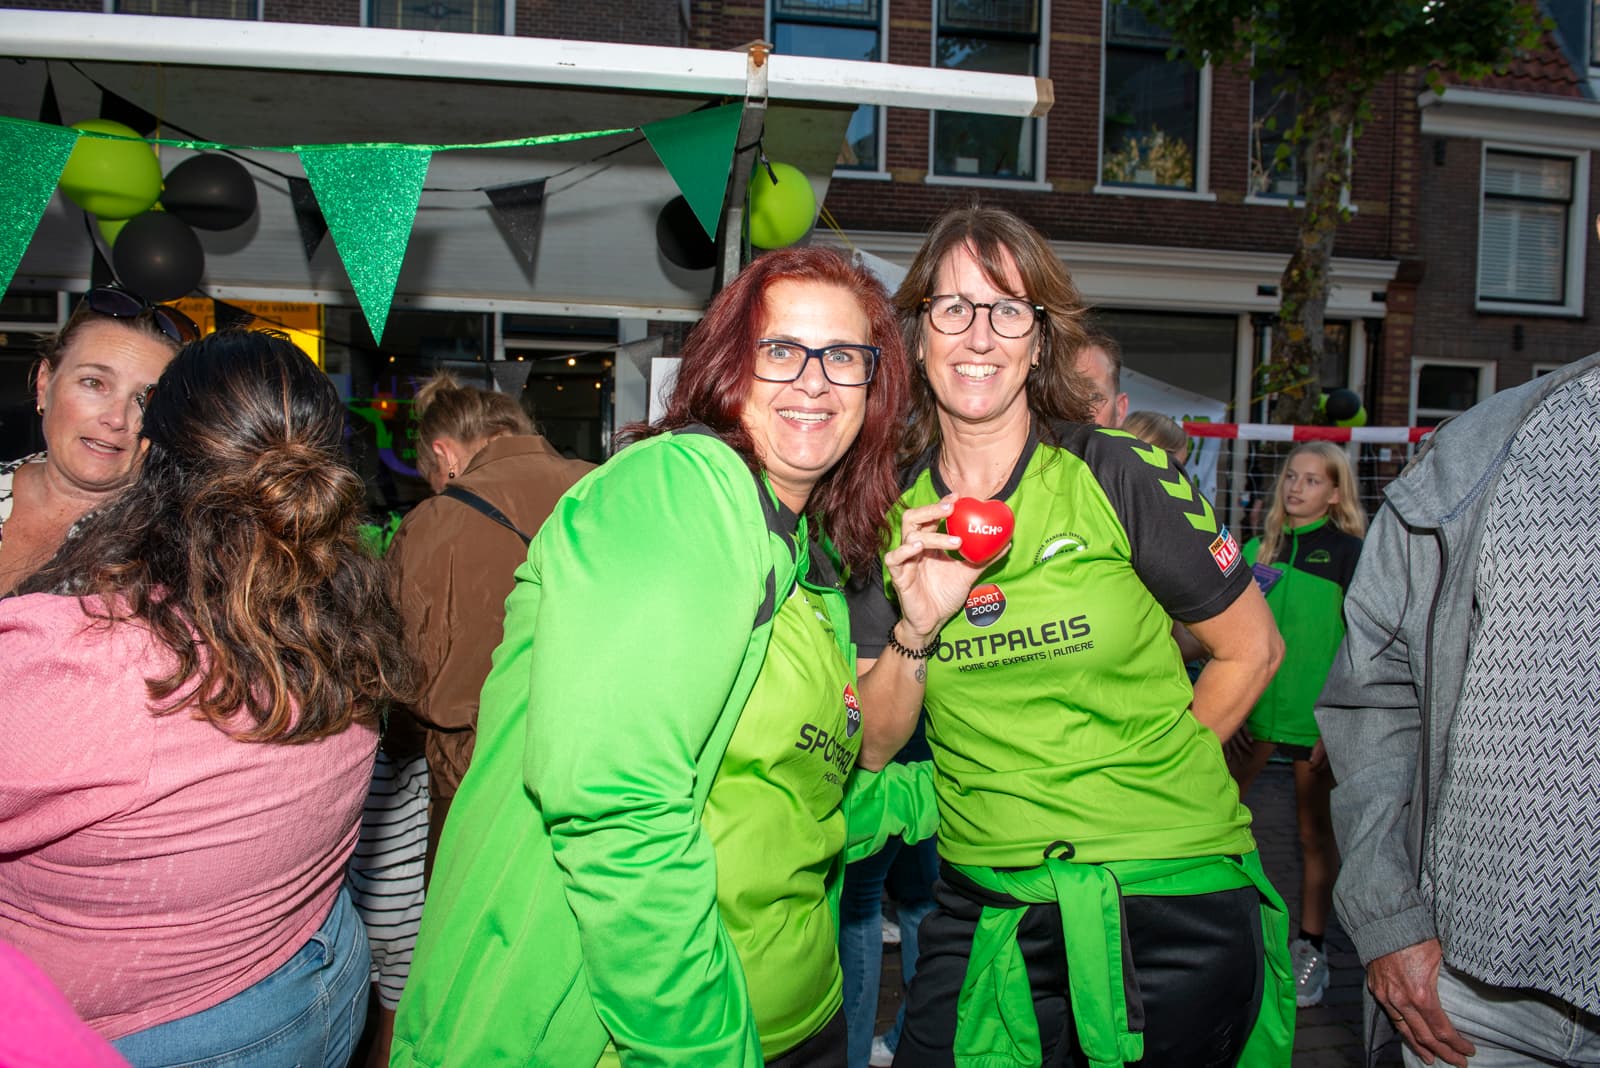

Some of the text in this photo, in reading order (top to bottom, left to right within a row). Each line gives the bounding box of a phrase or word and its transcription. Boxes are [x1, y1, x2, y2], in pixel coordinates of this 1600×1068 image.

[967, 592, 1000, 607] SPORT
[972, 602, 1000, 616] 2000
[958, 640, 1095, 673] HOME OF EXPERTS ALMERE
